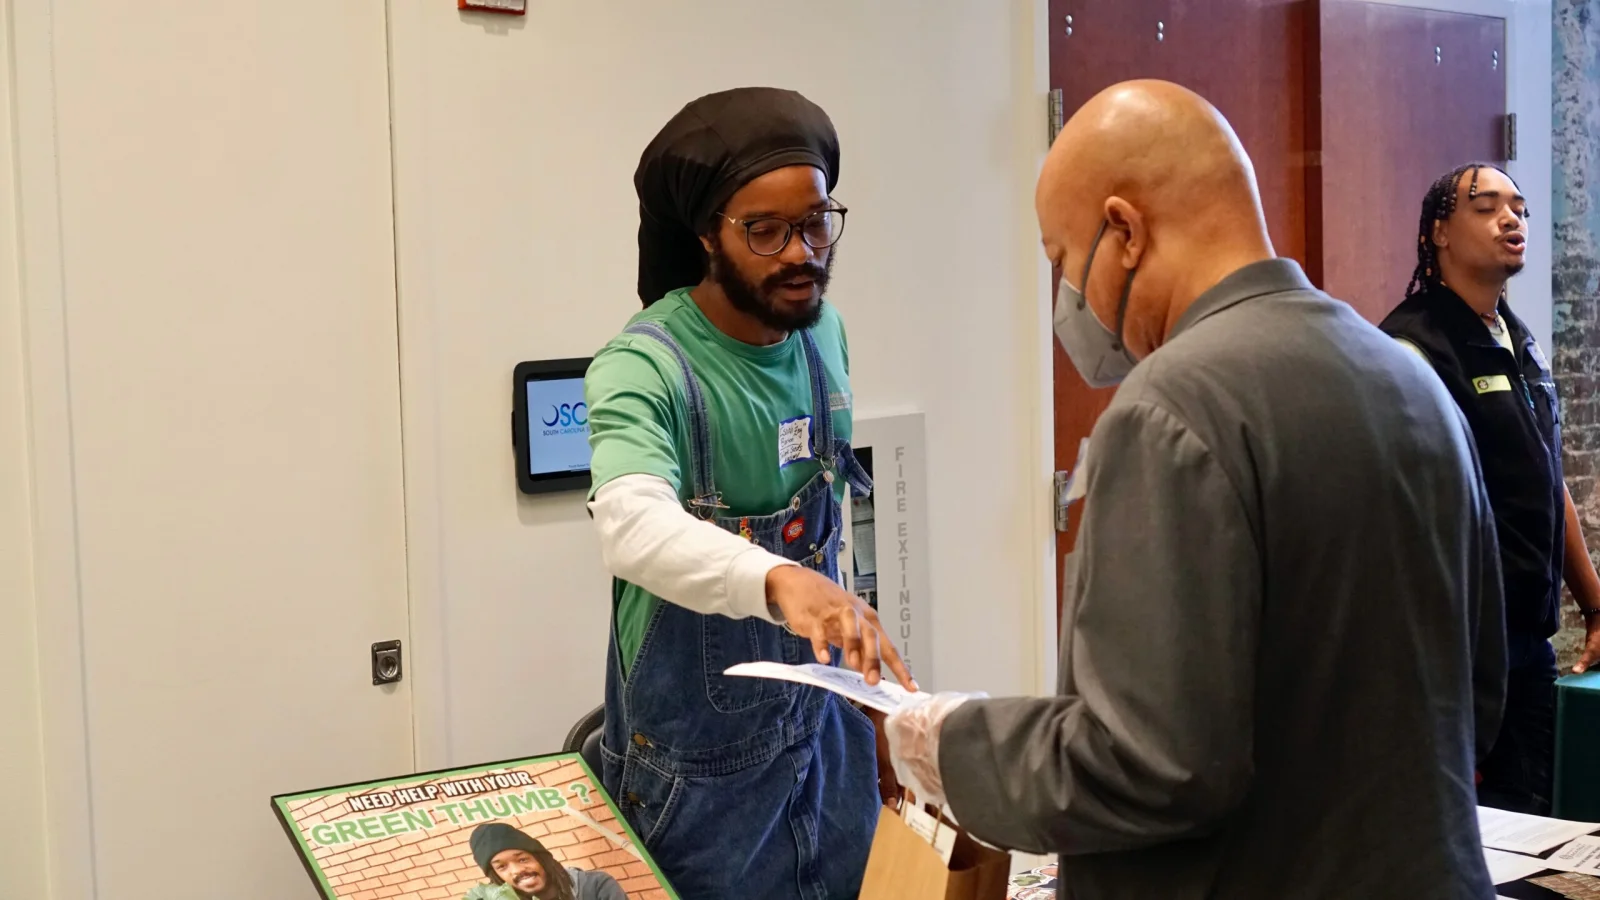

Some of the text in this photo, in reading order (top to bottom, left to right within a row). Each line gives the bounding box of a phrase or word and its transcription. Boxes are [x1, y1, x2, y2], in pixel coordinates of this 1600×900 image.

[560, 426, 586, 435] CAROLINA
[895, 446, 907, 512] FIRE
[349, 771, 534, 811] NEED HELP WITH YOUR
[311, 810, 436, 845] GREEN
[437, 788, 566, 824] THUMB
